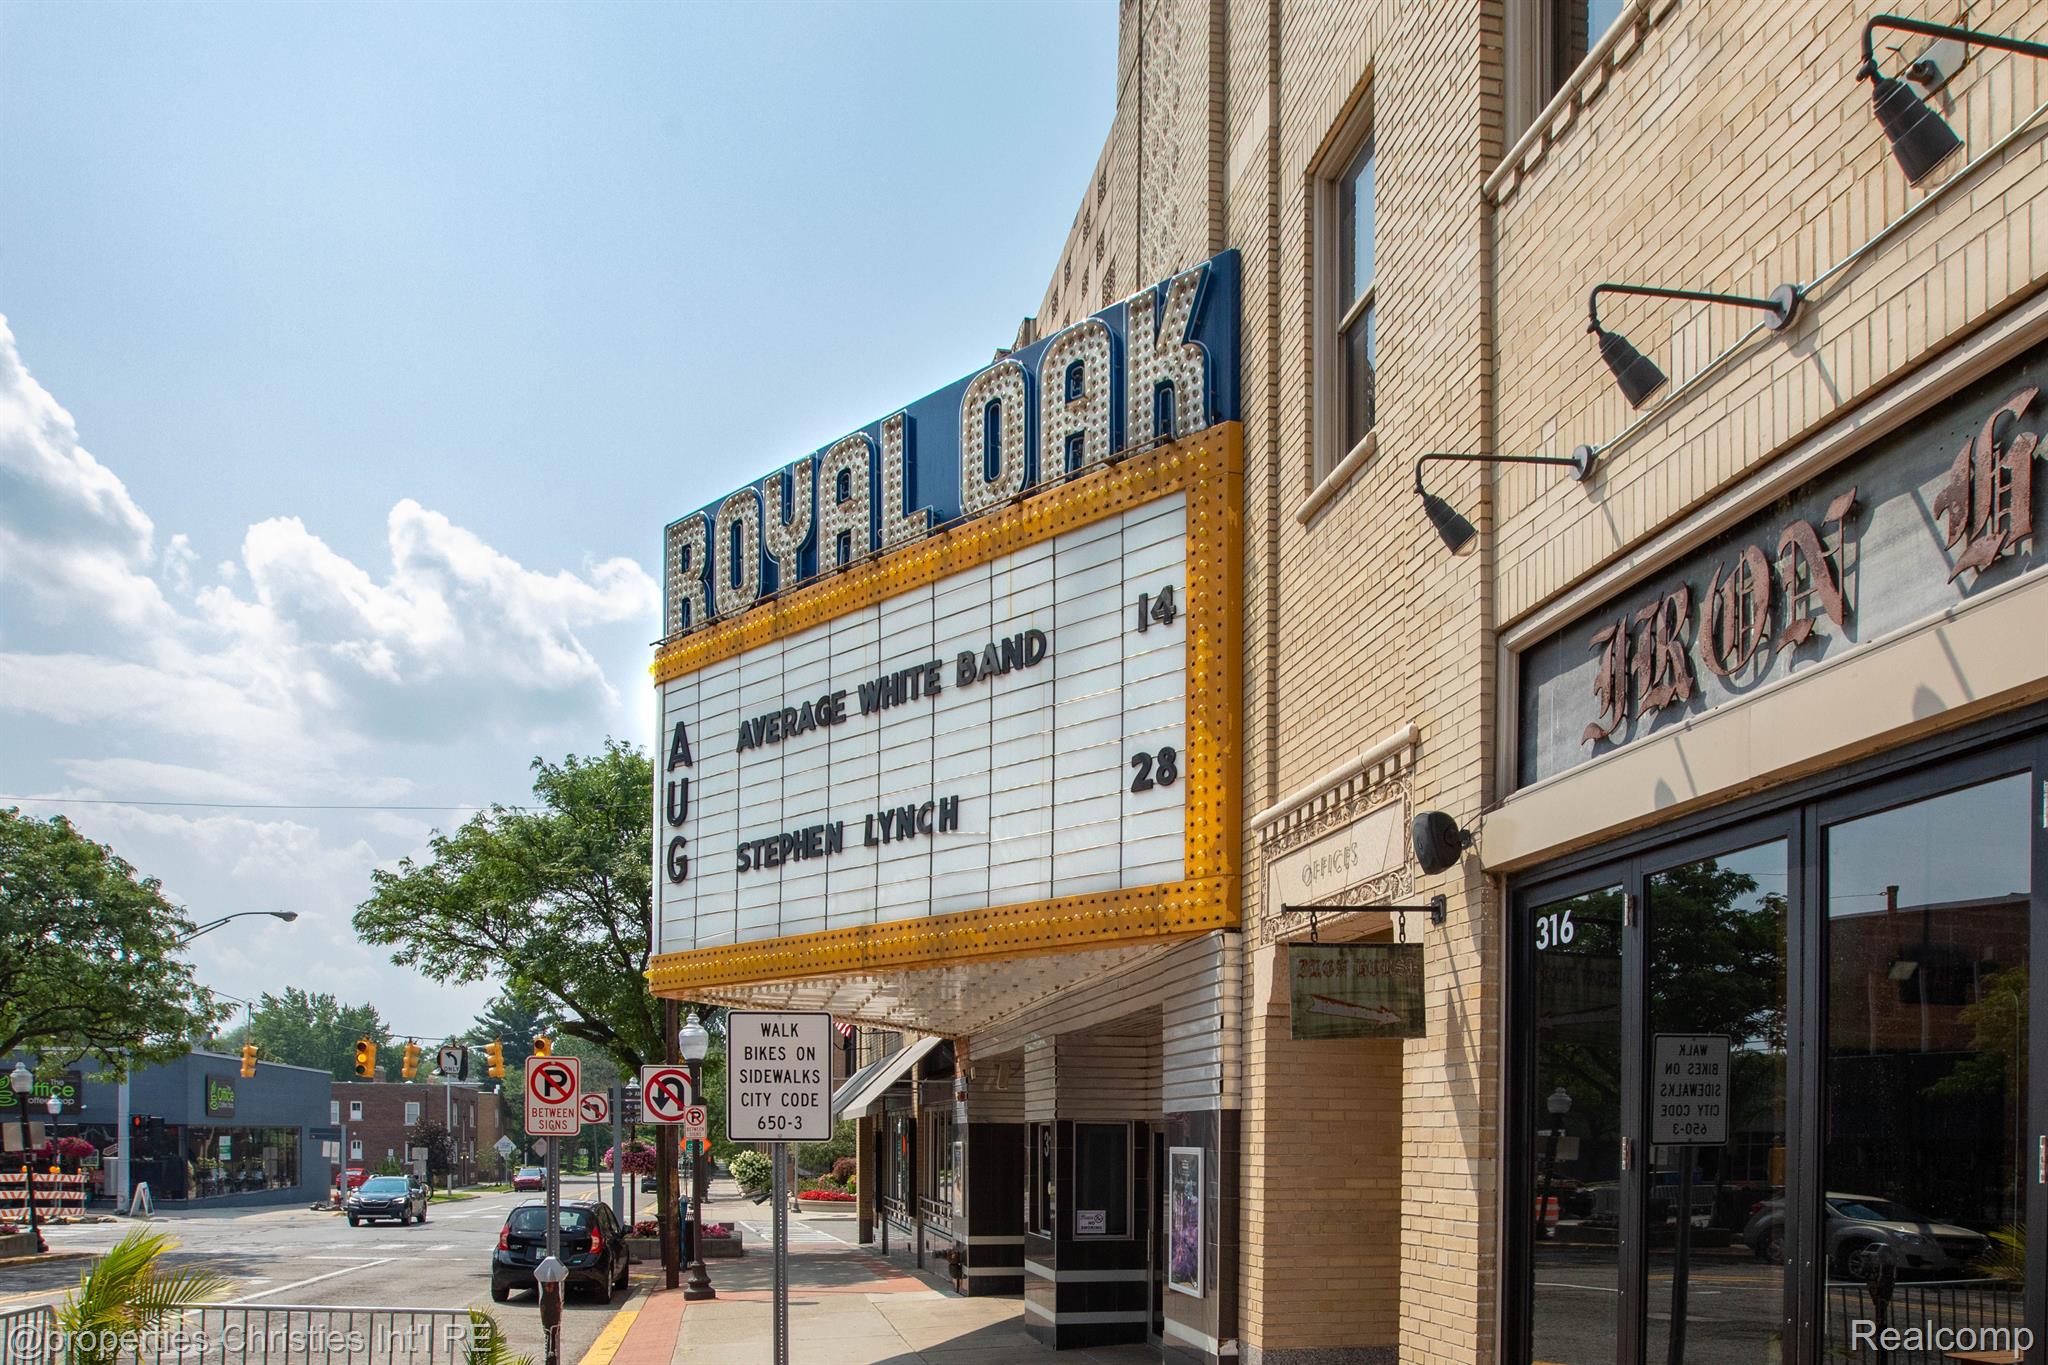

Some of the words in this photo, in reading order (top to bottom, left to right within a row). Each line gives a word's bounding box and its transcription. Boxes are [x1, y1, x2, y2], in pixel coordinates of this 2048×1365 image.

[666, 409, 934, 636] ROYAL
[959, 261, 1213, 516] OAK
[1137, 584, 1177, 633] 14
[1581, 486, 1857, 746] IRON
[736, 689, 847, 753] AVERAGE
[857, 658, 943, 716] WHITE
[956, 628, 1047, 688] BAND
[1131, 746, 1178, 793] 28
[736, 820, 843, 873] STEPHEN
[864, 795, 959, 847] LYNCH
[1301, 841, 1358, 887] OFFICES
[1535, 909, 1574, 950] 316
[760, 1022, 799, 1038] WALK
[744, 1046, 786, 1061] BIKES
[796, 1046, 815, 1061] ON
[739, 1069, 820, 1084] SIDEWALKS
[531, 1107, 575, 1118] BETWEEN
[741, 1092, 771, 1107] CITY
[781, 1092, 819, 1107] CODE
[538, 1120, 568, 1130] SIGNS
[757, 1115, 802, 1130] 650-3
